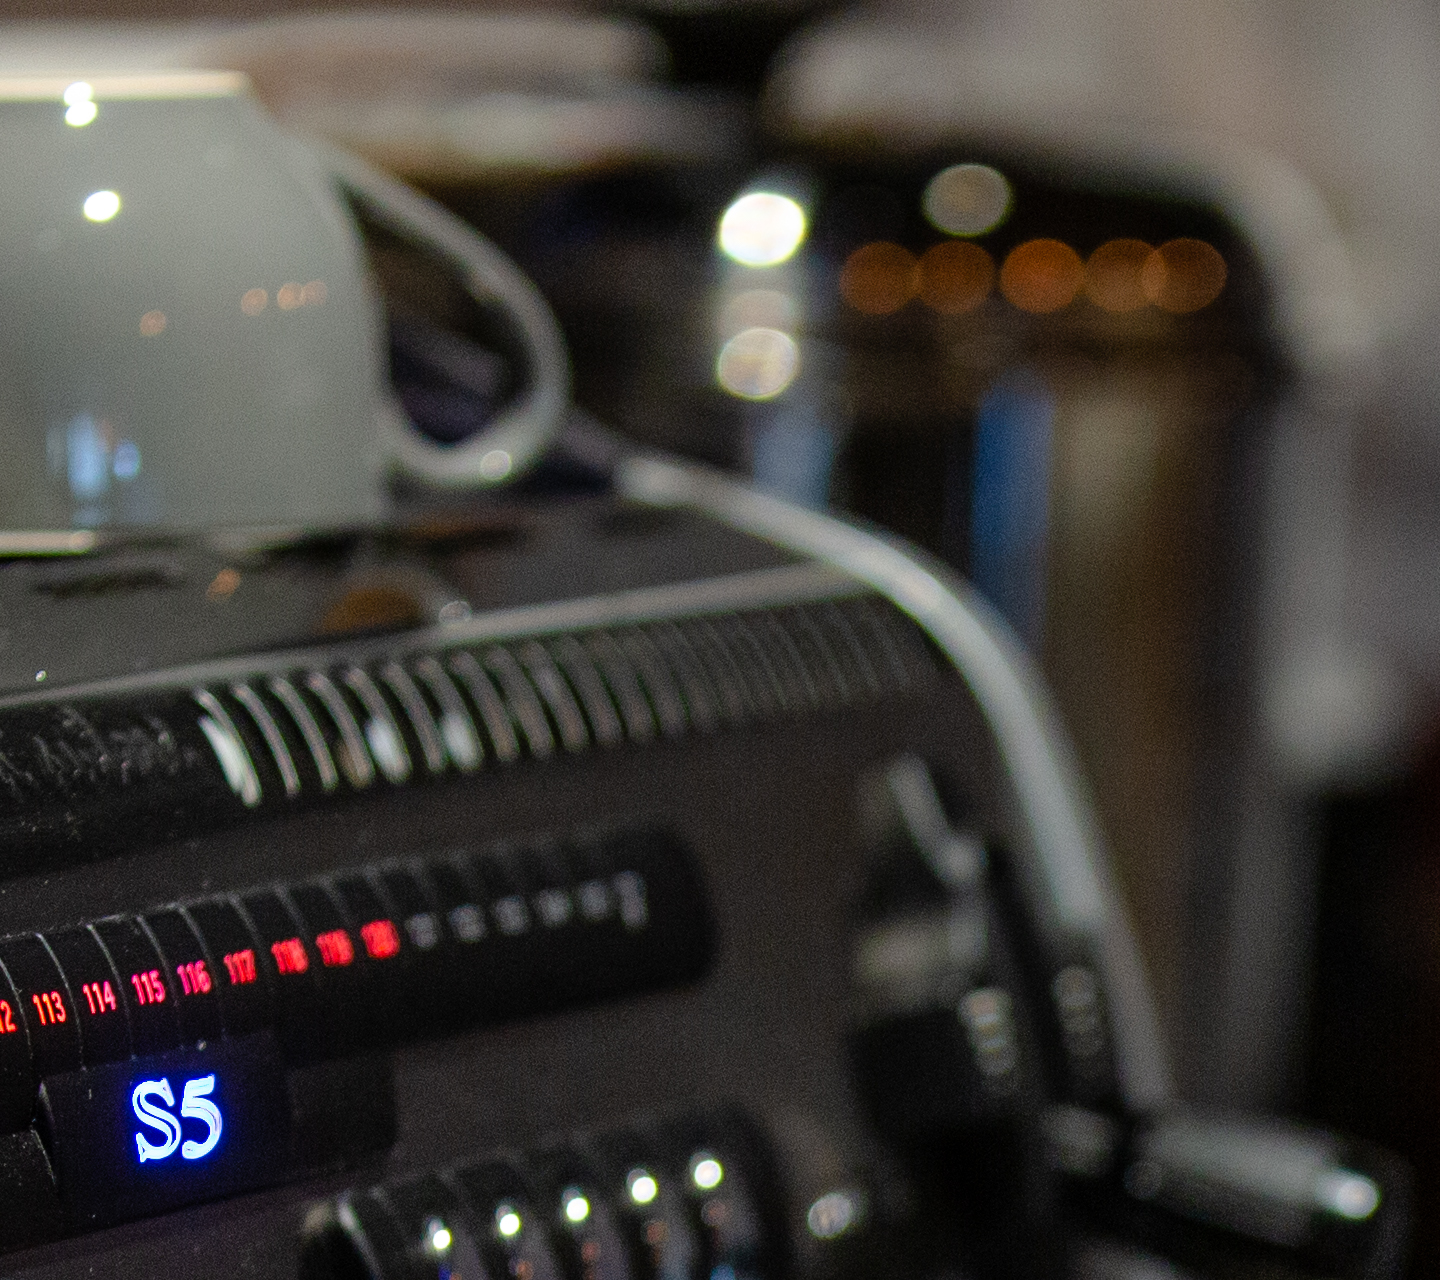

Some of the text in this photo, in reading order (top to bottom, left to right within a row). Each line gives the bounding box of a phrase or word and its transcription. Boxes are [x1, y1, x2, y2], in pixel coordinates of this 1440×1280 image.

[32, 991, 66, 1025] 113
[83, 981, 116, 1014] 114
[132, 970, 166, 1005] 115
[177, 960, 211, 995] 116
[224, 950, 256, 984] 117
[272, 939, 307, 974] 118
[131, 1073, 223, 1162] S5
